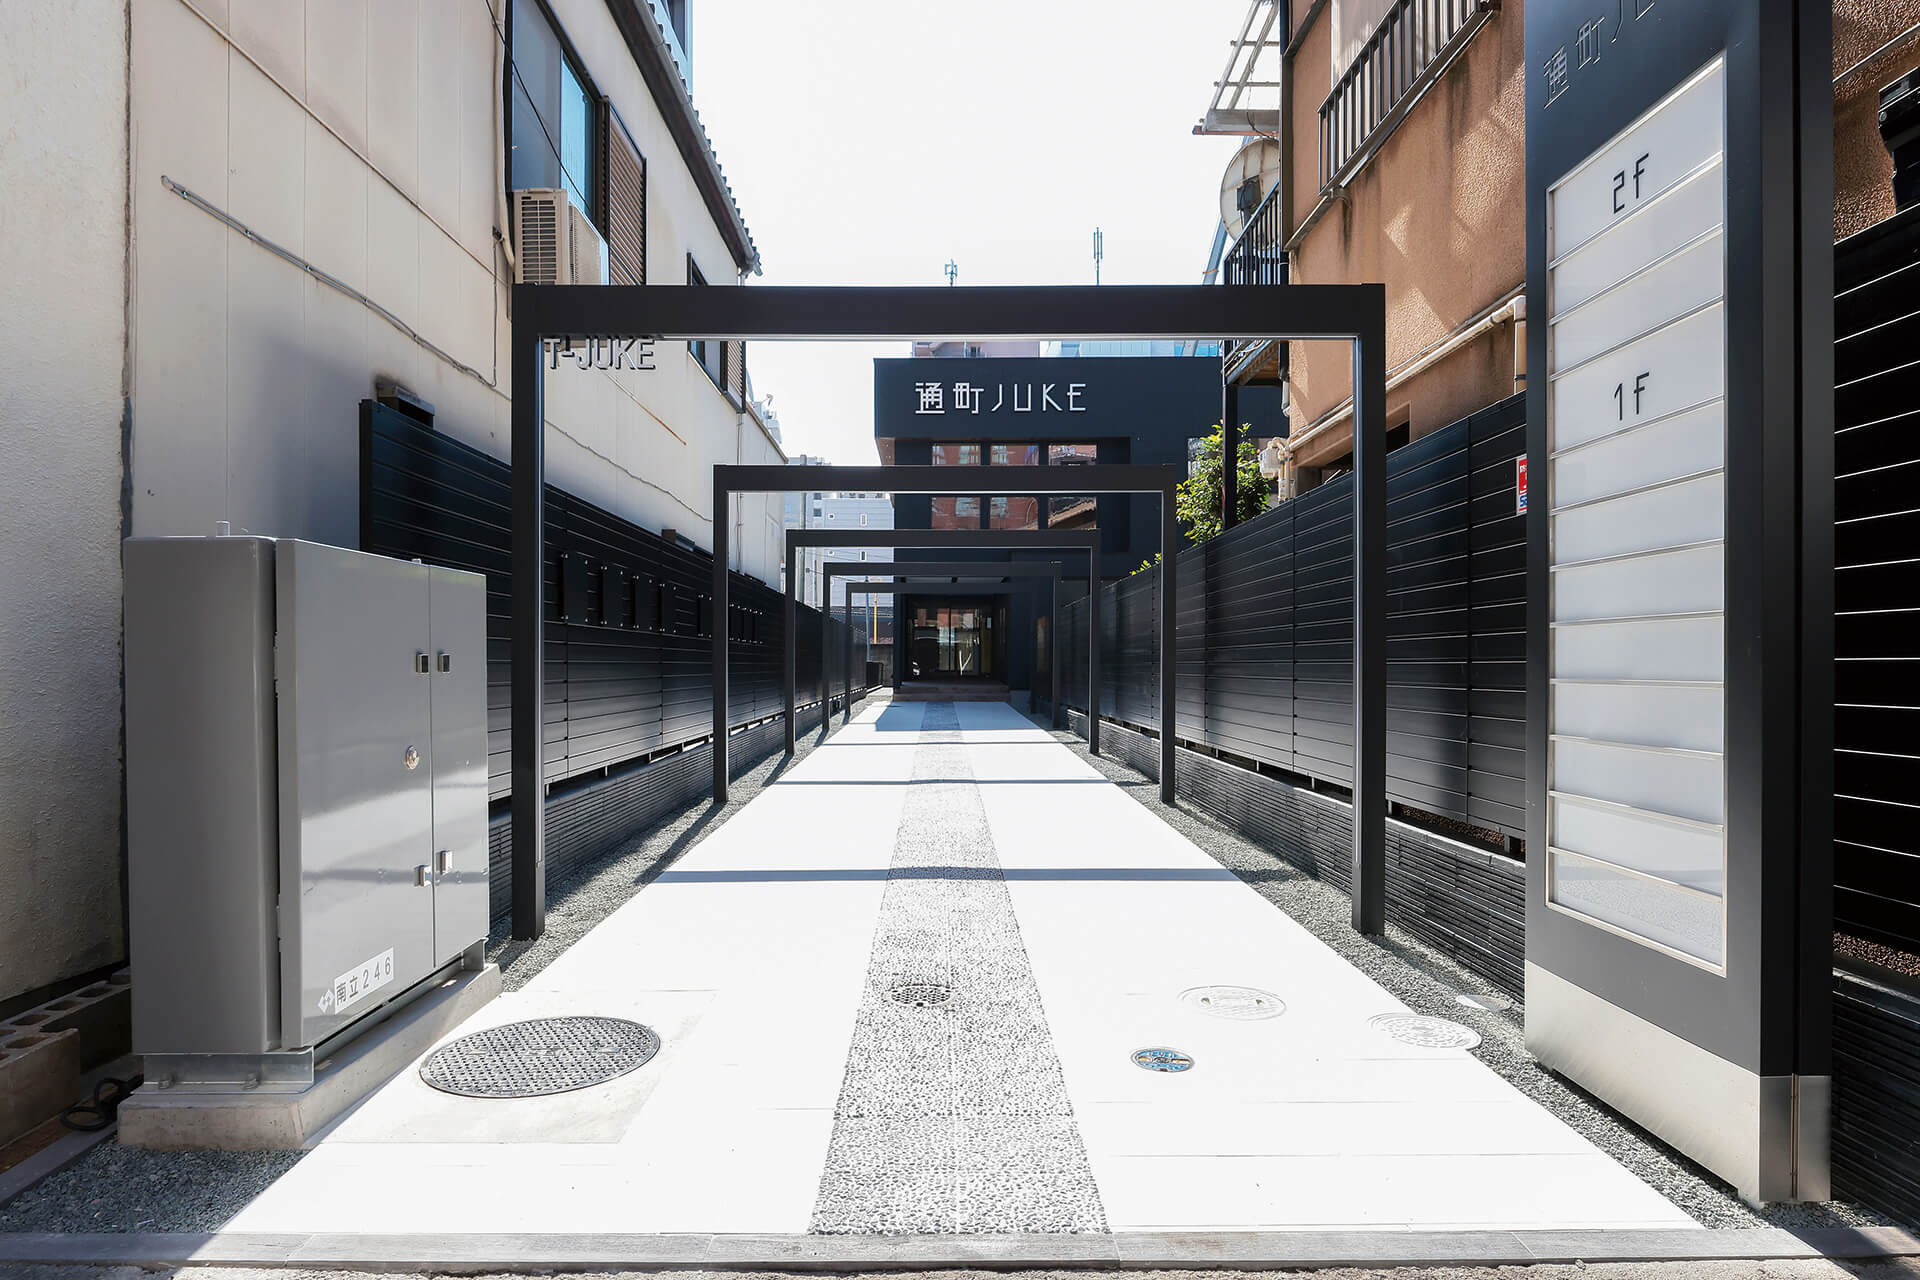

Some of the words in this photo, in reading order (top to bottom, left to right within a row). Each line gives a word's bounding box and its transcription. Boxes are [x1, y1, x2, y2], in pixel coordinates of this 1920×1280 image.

[1613, 153, 1649, 214] 2F
[543, 336, 656, 371] T-JUKE
[915, 382, 1086, 414] 通町JUKE
[1614, 371, 1650, 421] 1F
